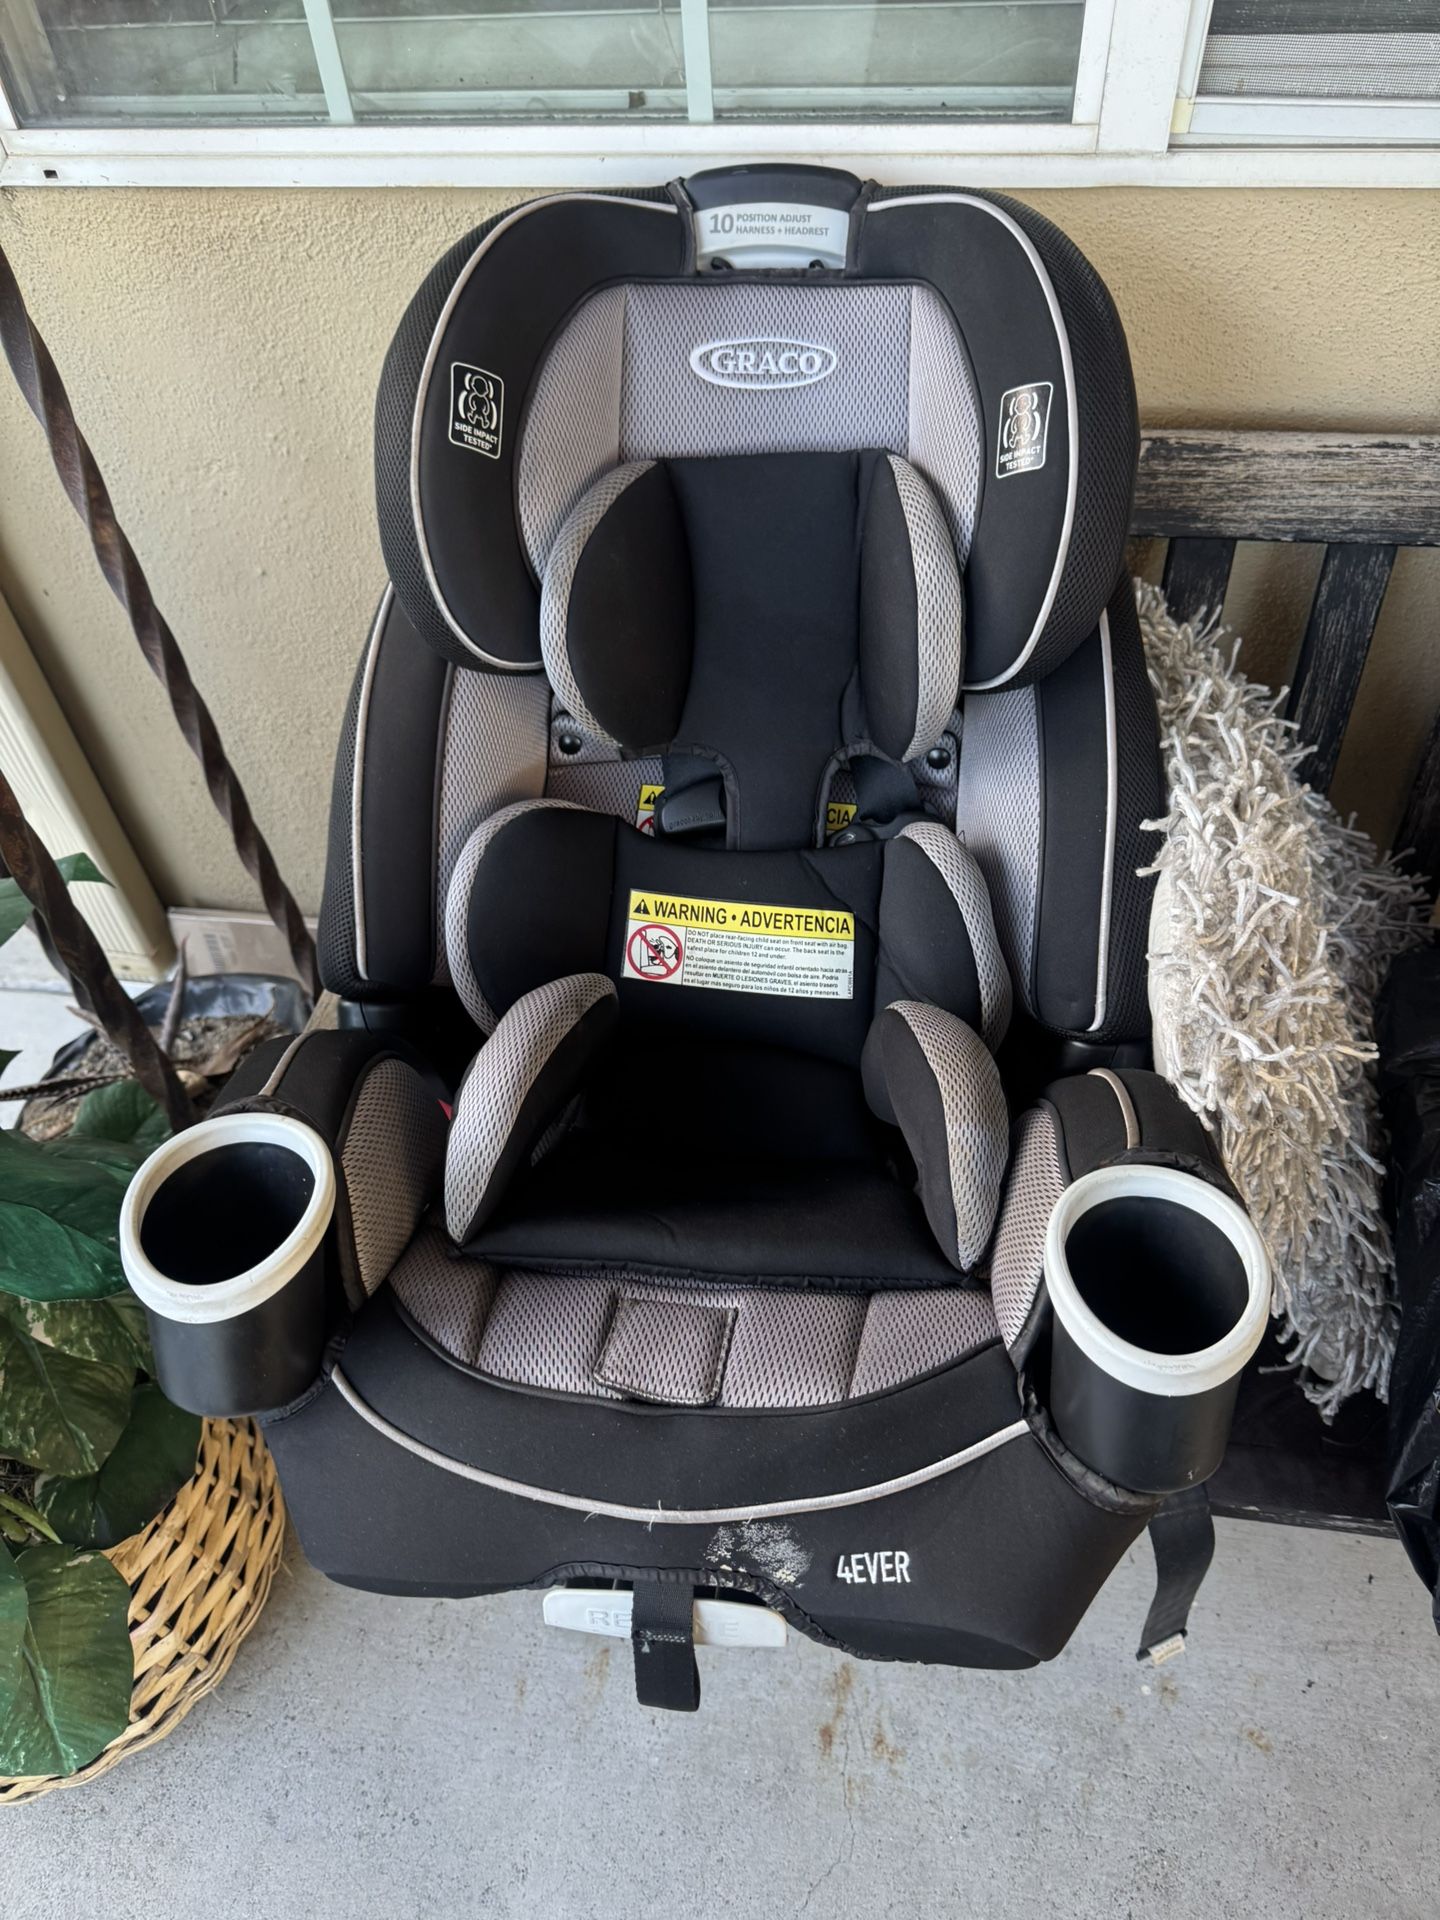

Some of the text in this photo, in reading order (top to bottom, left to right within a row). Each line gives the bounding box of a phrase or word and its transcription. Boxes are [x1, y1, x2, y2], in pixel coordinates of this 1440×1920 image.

[709, 213, 734, 234] 10
[736, 213, 812, 224] POSITION ADJUST
[736, 226, 775, 235] HARNESS
[784, 226, 829, 236] HEADREST
[710, 350, 822, 374] GRACO
[454, 421, 498, 444] SIDE IMPACT
[654, 900, 850, 934] WARNING ADVERTENCIA
[717, 940, 741, 948] SERIOUS
[726, 935, 754, 943] rear-facing
[712, 972, 735, 980] MUERTE
[837, 1551, 911, 1584] 4EVER
